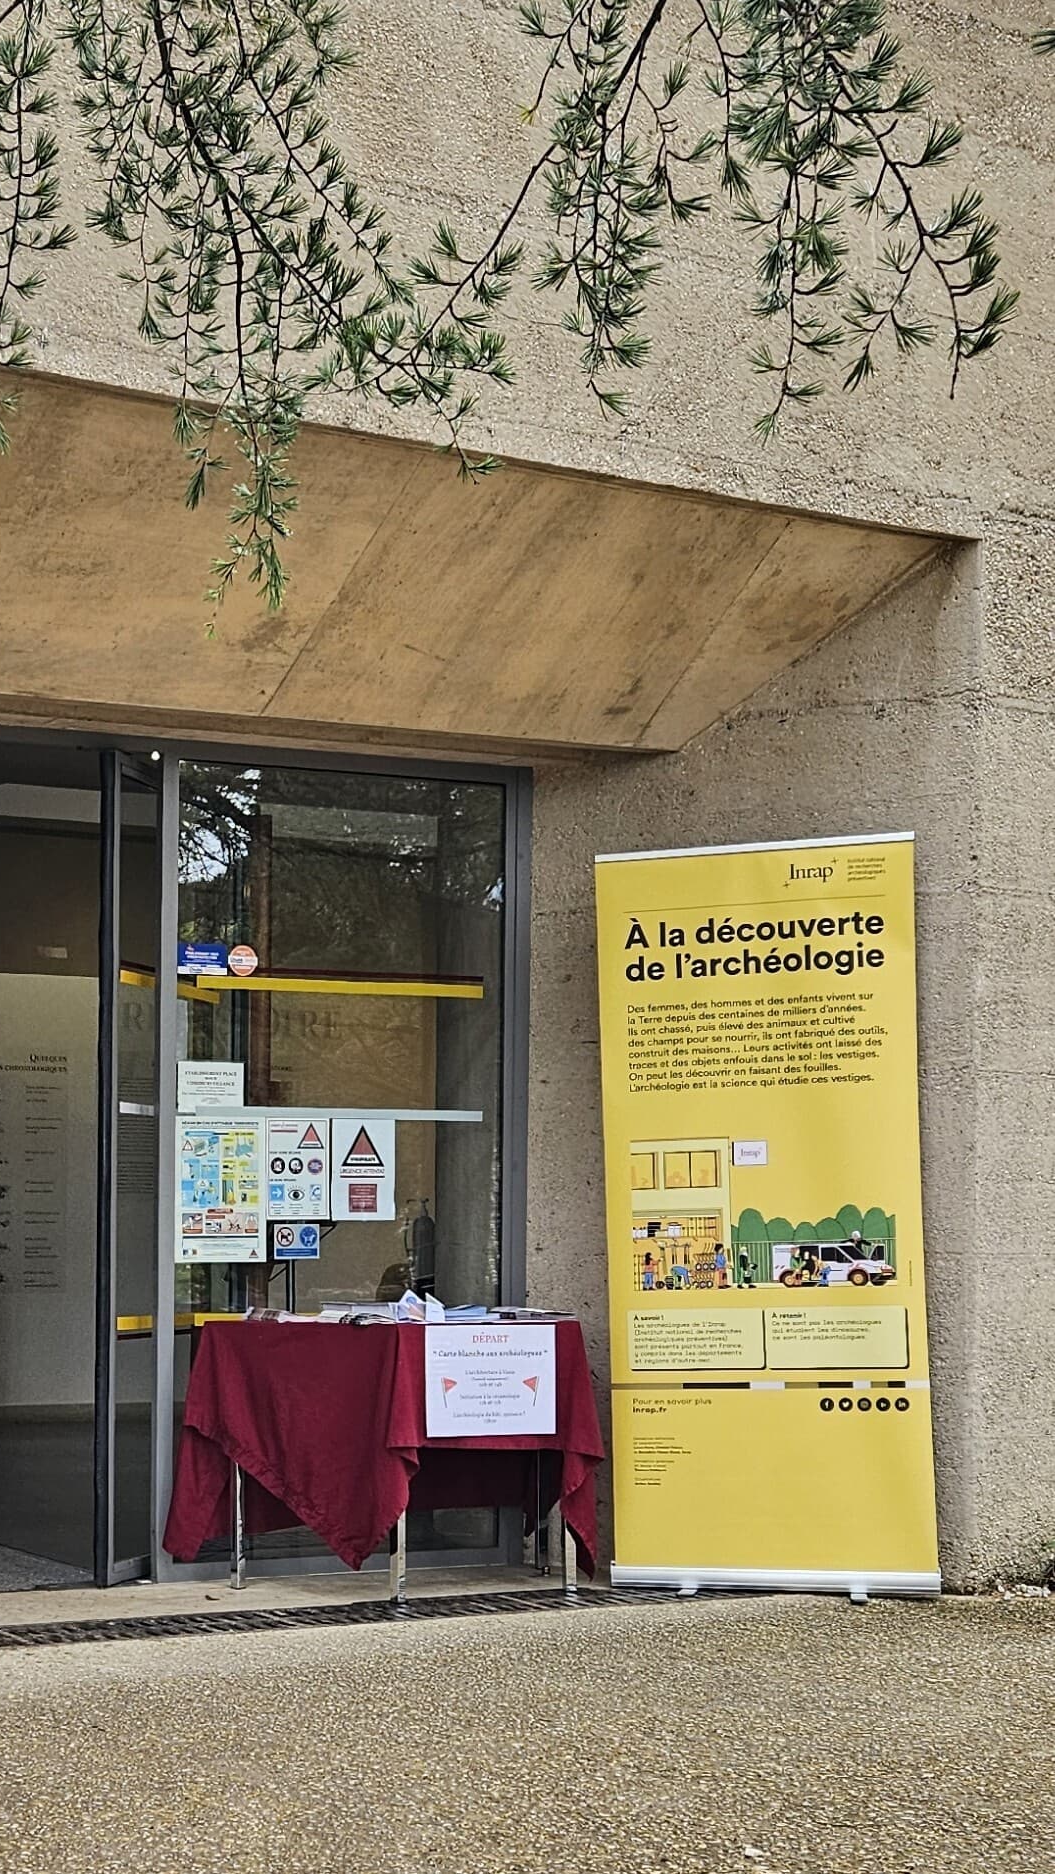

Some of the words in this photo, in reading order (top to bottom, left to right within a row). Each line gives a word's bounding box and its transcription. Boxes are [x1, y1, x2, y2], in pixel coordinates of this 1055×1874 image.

[790, 864, 833, 882] Inrap
[625, 918, 649, 949] À
[659, 922, 685, 947] la
[695, 912, 884, 944] découverte
[625, 956, 665, 981] de
[627, 1004, 645, 1013] Des
[647, 1003, 689, 1012] femmes,
[691, 1001, 708, 1009] des
[711, 1000, 752, 1008] hommes
[755, 997, 764, 1006] et
[767, 997, 785, 1005] des
[787, 994, 823, 1004] enfants
[826, 992, 855, 1002] vivent
[627, 1016, 635, 1024] la
[639, 1015, 663, 1024] Terre
[665, 1013, 696, 1024] depuis
[698, 1012, 716, 1020] des
[718, 1010, 765, 1019] centaines
[767, 1008, 779, 1017] de
[783, 1006, 817, 1016] milliers
[819, 1004, 866, 1014] d'années.
[628, 1027, 638, 1036] Ils
[641, 1026, 656, 1035] ont
[658, 1024, 693, 1034] chassé,
[696, 1023, 716, 1034] puis
[718, 1021, 744, 1031] élevé
[746, 1021, 764, 1029] des
[766, 1019, 807, 1028] animaux
[810, 1017, 820, 1026] et
[823, 1015, 855, 1025] cultivé
[628, 1039, 645, 1047] des
[647, 1037, 684, 1047] champs
[687, 1037, 709, 1046] pour
[725, 1032, 760, 1042] nourrir,
[762, 1032, 773, 1040] ils
[775, 1030, 792, 1039] ont
[794, 1028, 835, 1039] fabriqué
[838, 1027, 855, 1036] des
[858, 1025, 888, 1035] outils,
[629, 1072, 643, 1081] On
[646, 1071, 667, 1082] peut
[670, 1070, 683, 1079] les
[685, 1068, 731, 1078] découvrir
[749, 1065, 781, 1075] faisant
[783, 1065, 801, 1073] des
[803, 1063, 841, 1072] fouilles.
[473, 1332, 509, 1344] DÉPART
[633, 1406, 667, 1415] inrap.fr
[695, 1397, 712, 1406] plus
